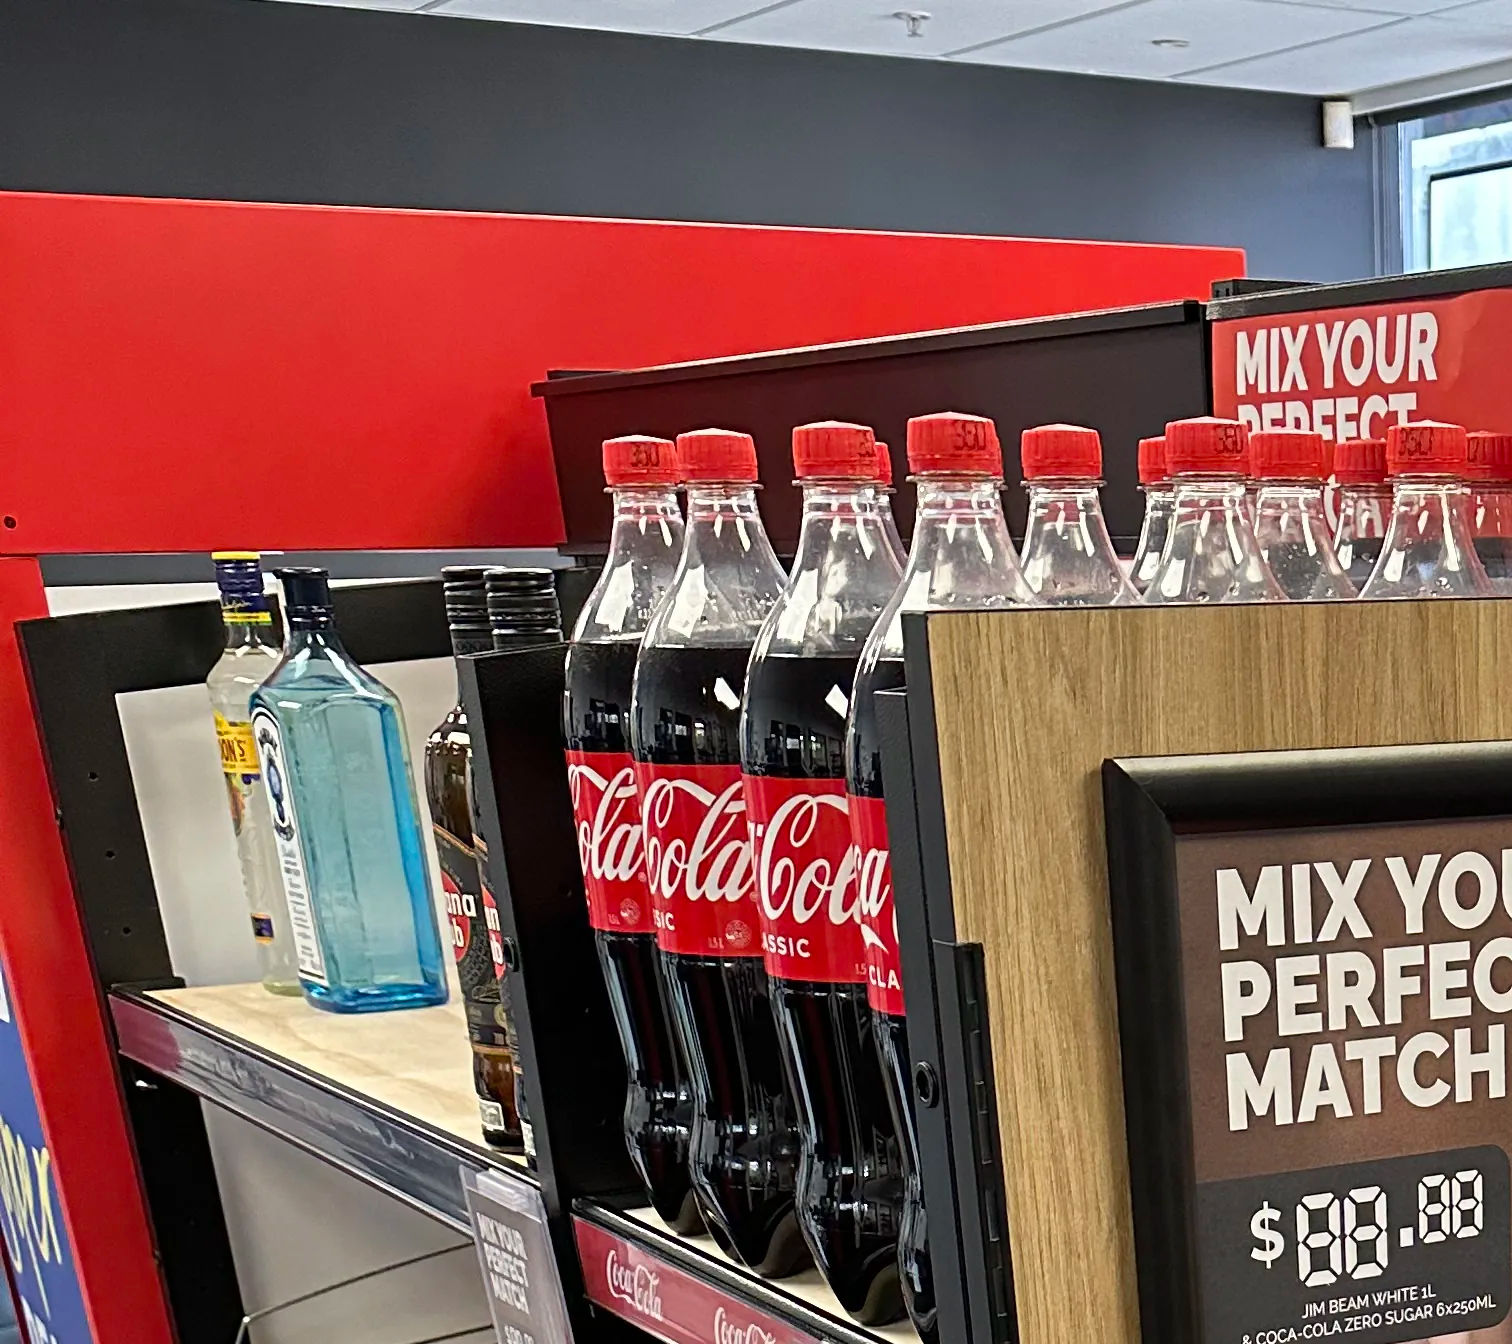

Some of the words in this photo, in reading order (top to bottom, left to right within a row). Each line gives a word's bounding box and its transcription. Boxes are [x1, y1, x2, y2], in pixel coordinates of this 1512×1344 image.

[1236, 326, 1309, 395] MIX
[1315, 312, 1438, 389] YOUR
[1216, 857, 1374, 951] MIX
[1225, 1023, 1507, 1132] MATCH
[606, 1250, 663, 1322] Coca-Cola
[1302, 1300, 1325, 1319] JIM
[1329, 1296, 1370, 1314] BEAM
[1372, 1288, 1418, 1310] WHITE
[1421, 1284, 1436, 1300] 1L
[1344, 1312, 1382, 1333] ZERO
[1385, 1305, 1432, 1326] SUGAR
[1436, 1293, 1496, 1316] 6x250ML
